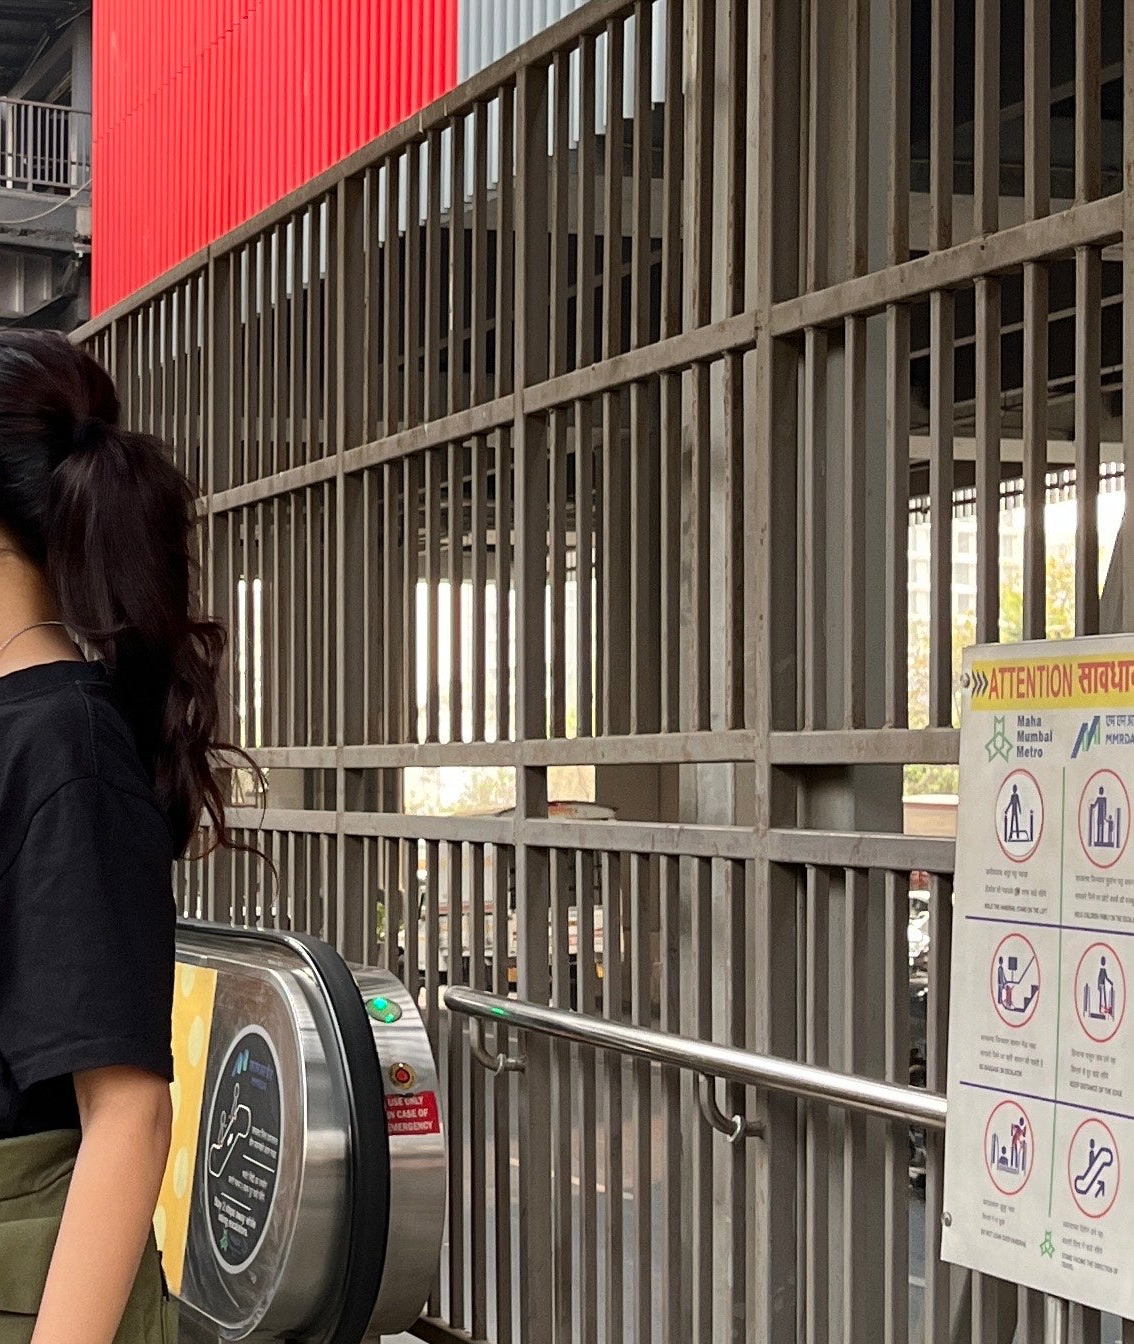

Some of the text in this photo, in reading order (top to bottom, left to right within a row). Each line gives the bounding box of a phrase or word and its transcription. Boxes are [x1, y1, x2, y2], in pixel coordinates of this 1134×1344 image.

[988, 663, 1073, 699] ATTENTION
[1017, 715, 1042, 727] Maha
[1016, 746, 1043, 758] Metro
[387, 1096, 424, 1106] USE ONLY
[396, 1109, 417, 1118] CASE
[418, 1108, 428, 1117] OF
